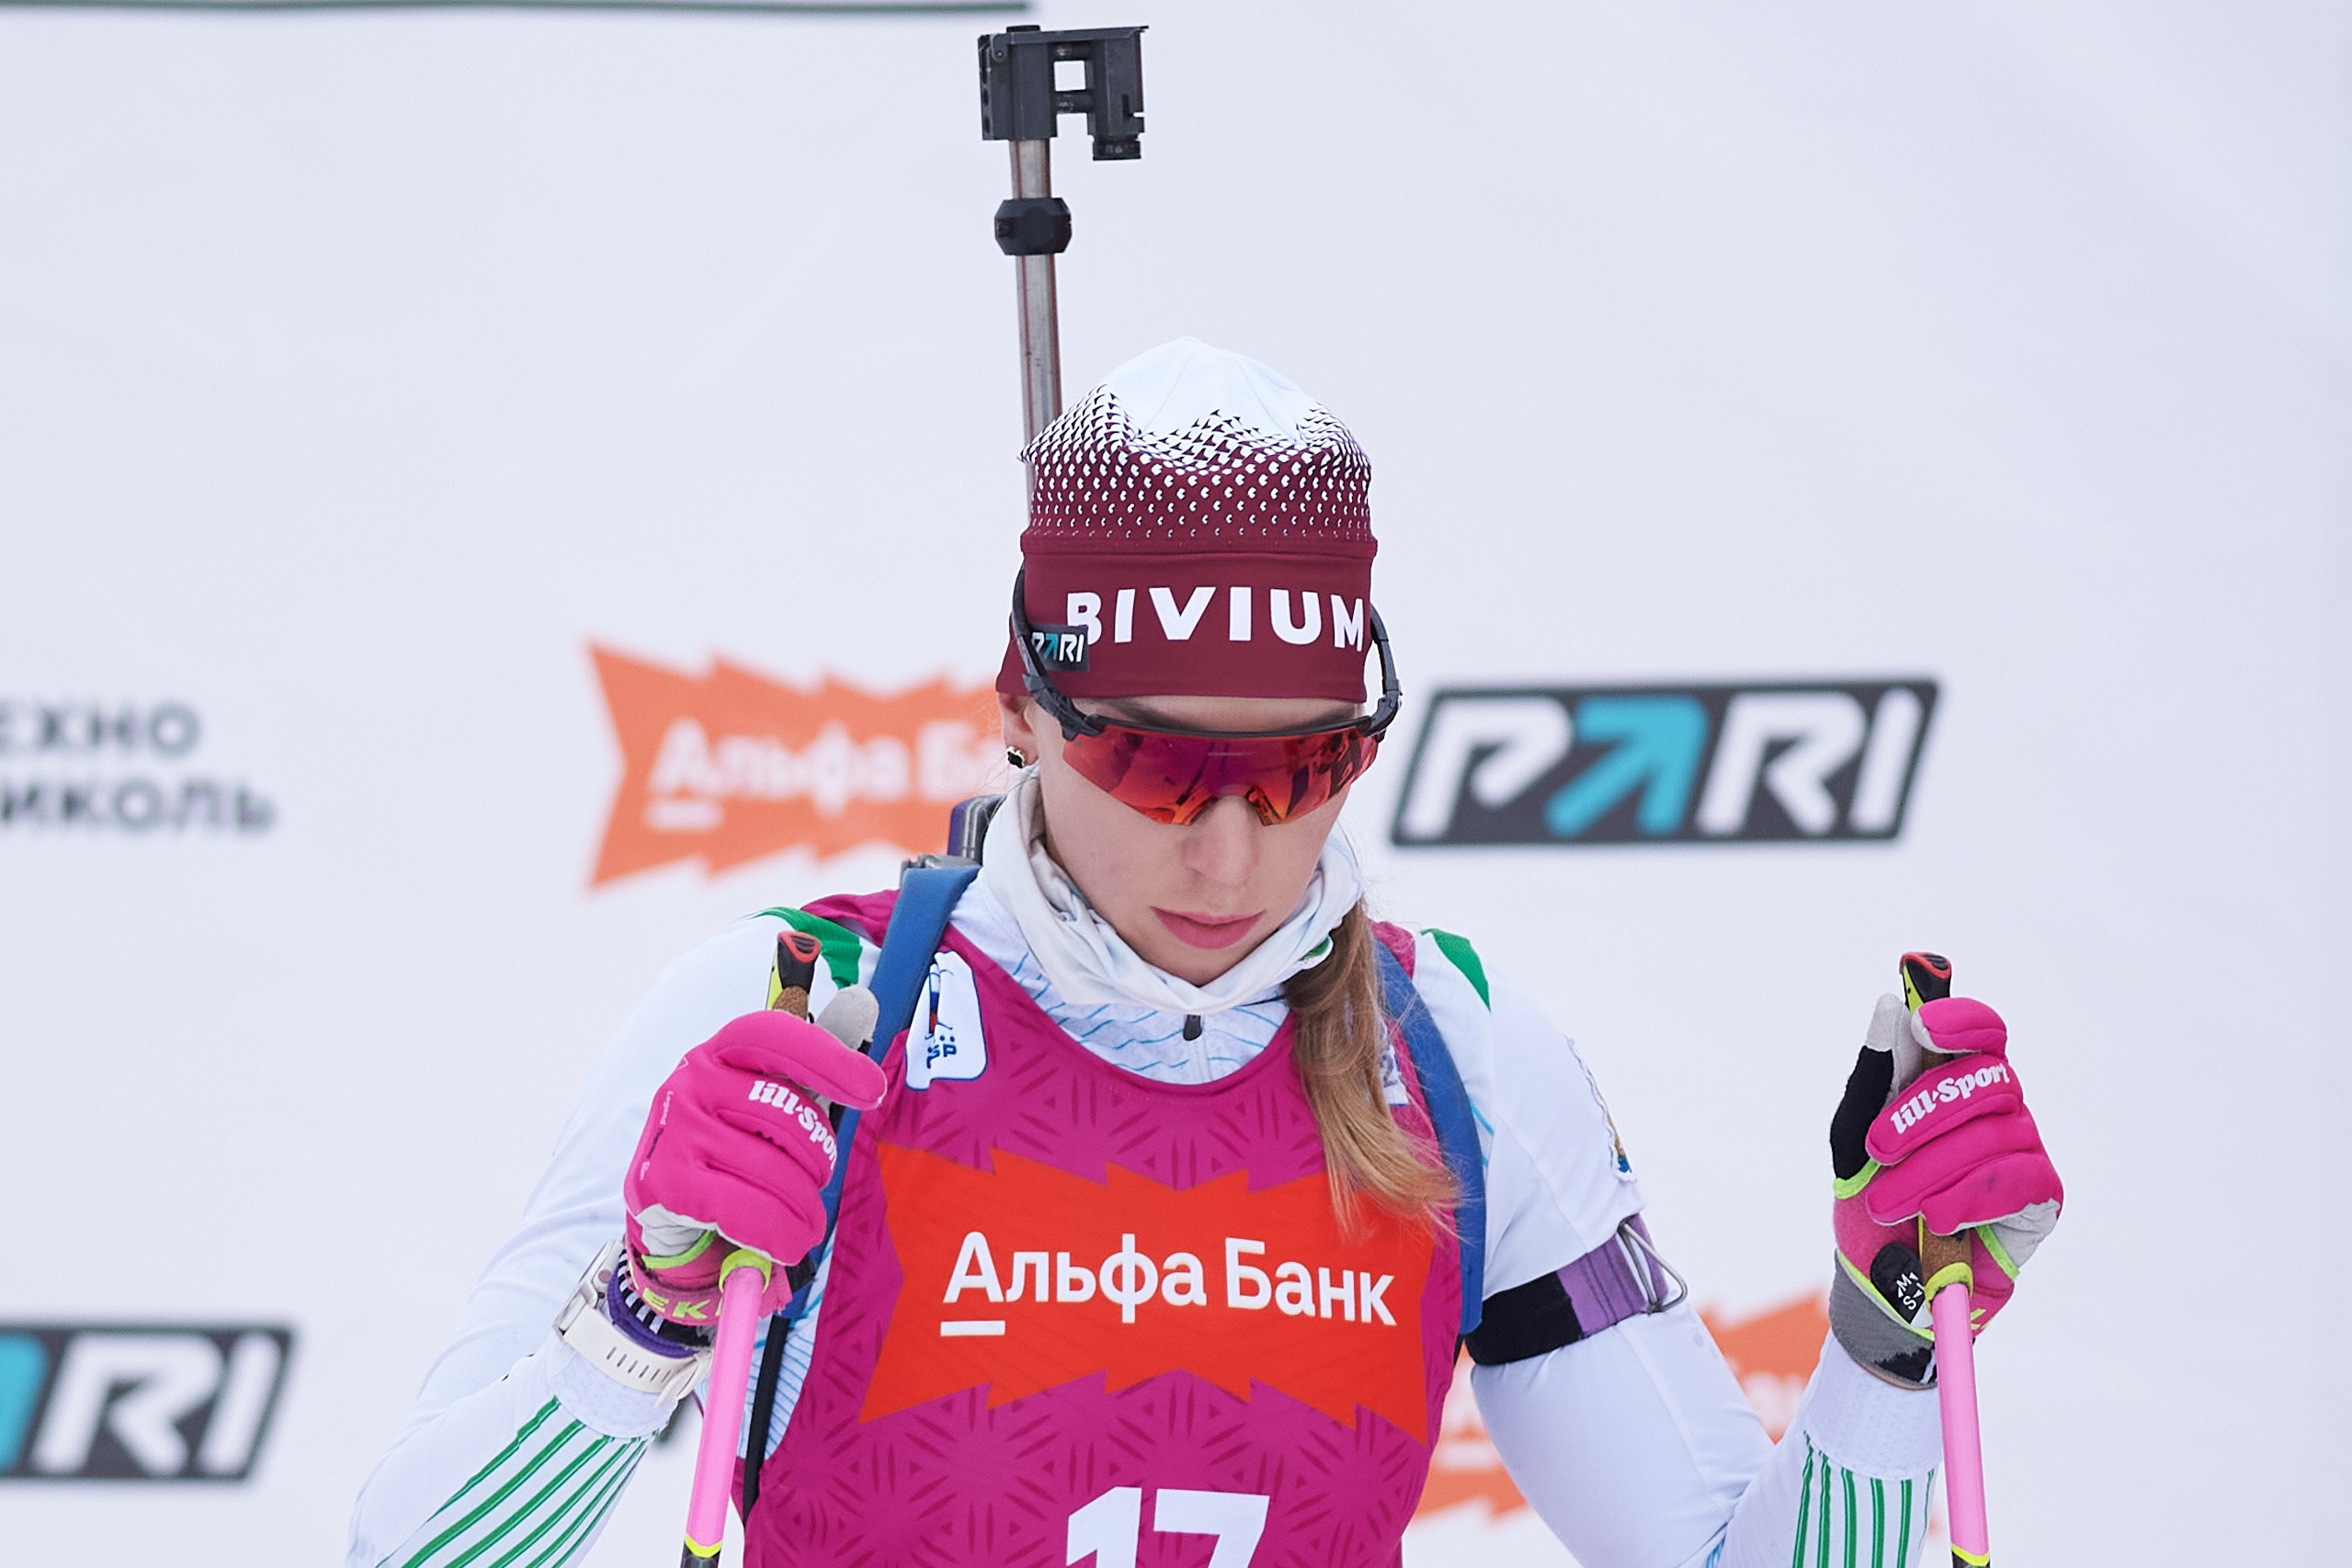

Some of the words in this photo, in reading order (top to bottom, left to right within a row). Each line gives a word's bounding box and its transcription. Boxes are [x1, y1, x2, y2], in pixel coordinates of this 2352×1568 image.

[1066, 585, 1364, 653] BIVIUM
[1399, 687, 1926, 839] PARI
[941, 1232, 1207, 1325] Альфа
[1225, 1237, 1397, 1326] Банк
[1066, 1486, 1270, 1568] 17
